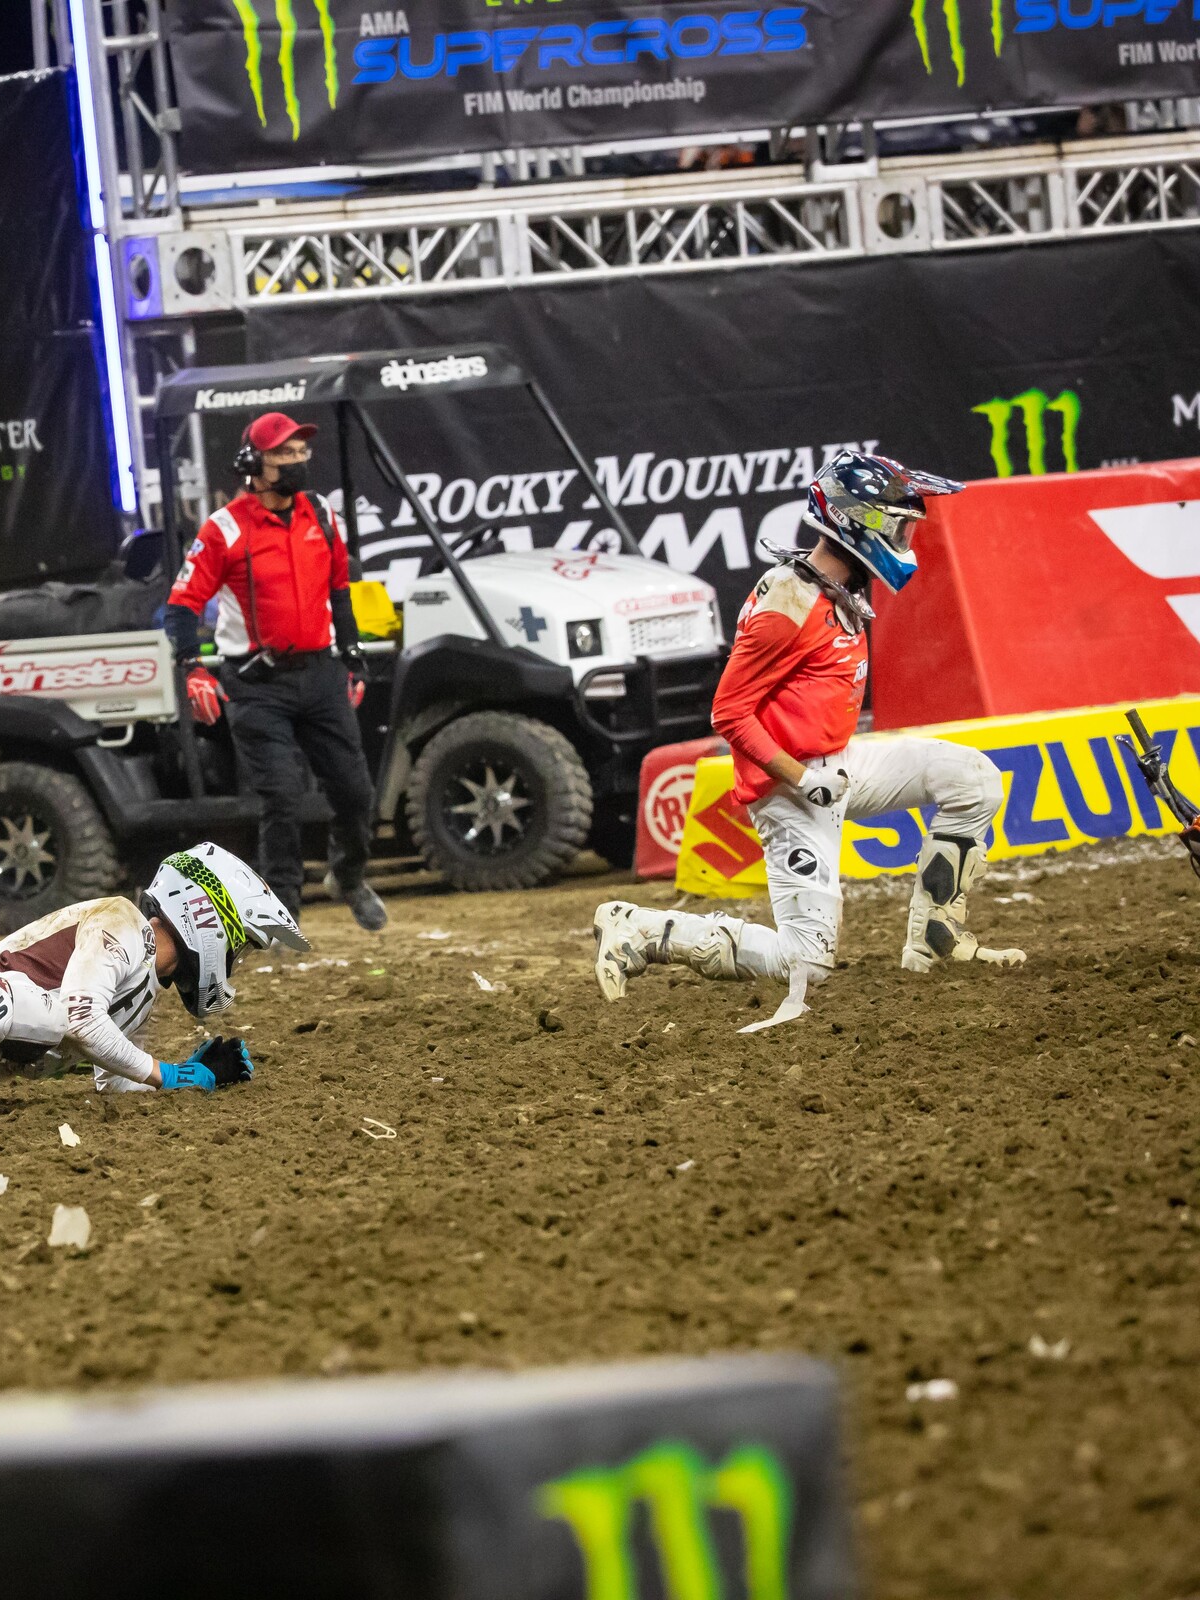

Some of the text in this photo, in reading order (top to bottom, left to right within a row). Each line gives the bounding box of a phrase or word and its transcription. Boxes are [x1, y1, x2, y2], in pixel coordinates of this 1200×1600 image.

[359, 11, 409, 37] AMA
[351, 8, 808, 85] SUPERCROSS
[1118, 42, 1153, 66] FIM
[464, 78, 707, 116] FIM World Championship
[380, 355, 488, 390] alpinestars
[194, 380, 308, 409] Kawasaki
[391, 441, 880, 527] ROCKY MOUNTA
[828, 504, 846, 524] BELL
[188, 895, 218, 930] FLY
